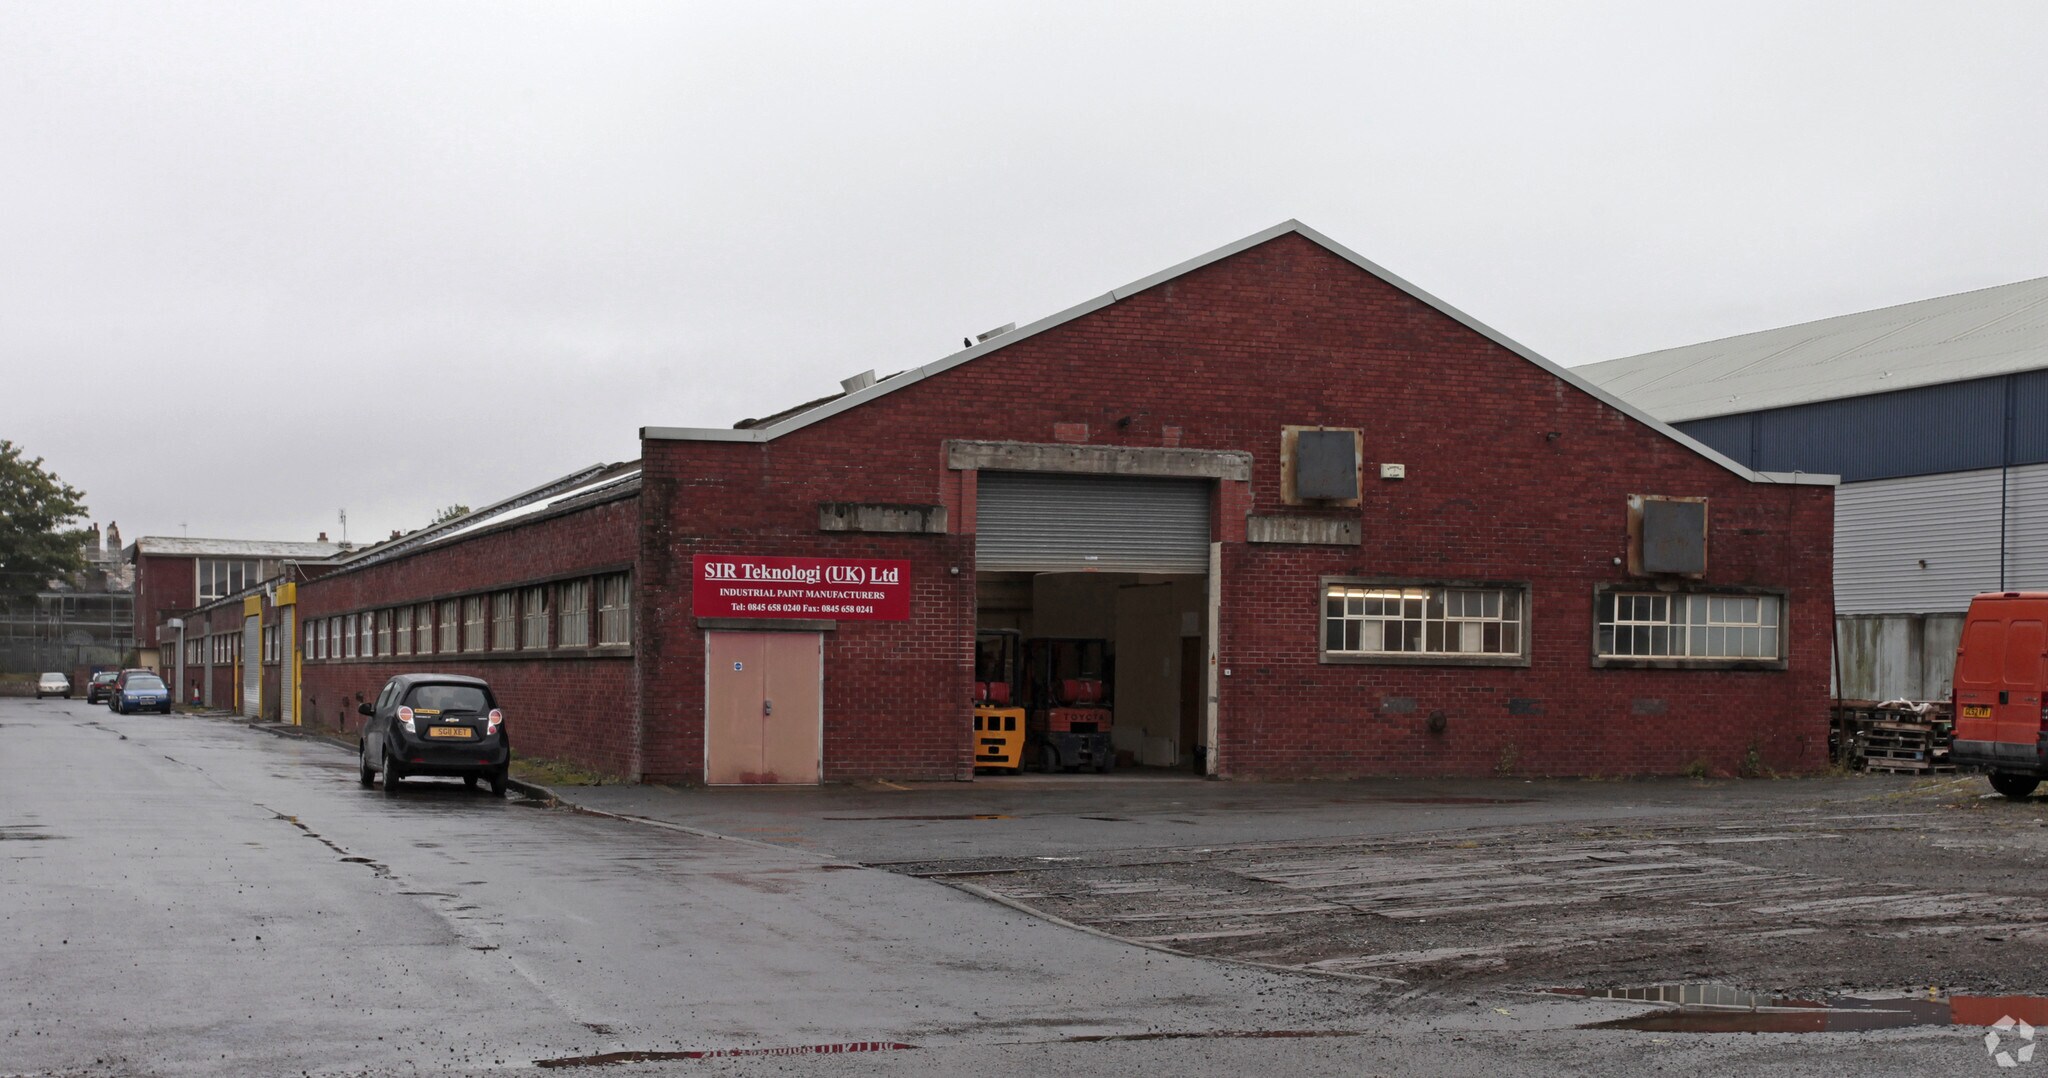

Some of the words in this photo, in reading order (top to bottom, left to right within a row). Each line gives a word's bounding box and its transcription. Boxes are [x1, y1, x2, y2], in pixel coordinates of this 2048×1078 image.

[704, 562, 737, 580] SIR
[741, 563, 821, 584] Teknologi
[825, 565, 866, 585] (UK)
[869, 566, 899, 583] Ltd
[719, 588, 776, 597] INDUSTRIAL
[777, 589, 804, 598] PAINT
[805, 590, 885, 600] MANUFACTURERS
[730, 602, 746, 611] Tel:
[747, 603, 766, 612] 0845
[767, 604, 782, 612] 658
[782, 604, 801, 612] 0240
[802, 604, 820, 613] Fax:
[821, 604, 840, 613] 0845
[840, 605, 855, 613] 658
[856, 605, 874, 614] 0241
[1064, 712, 1104, 721] TOYOTA
